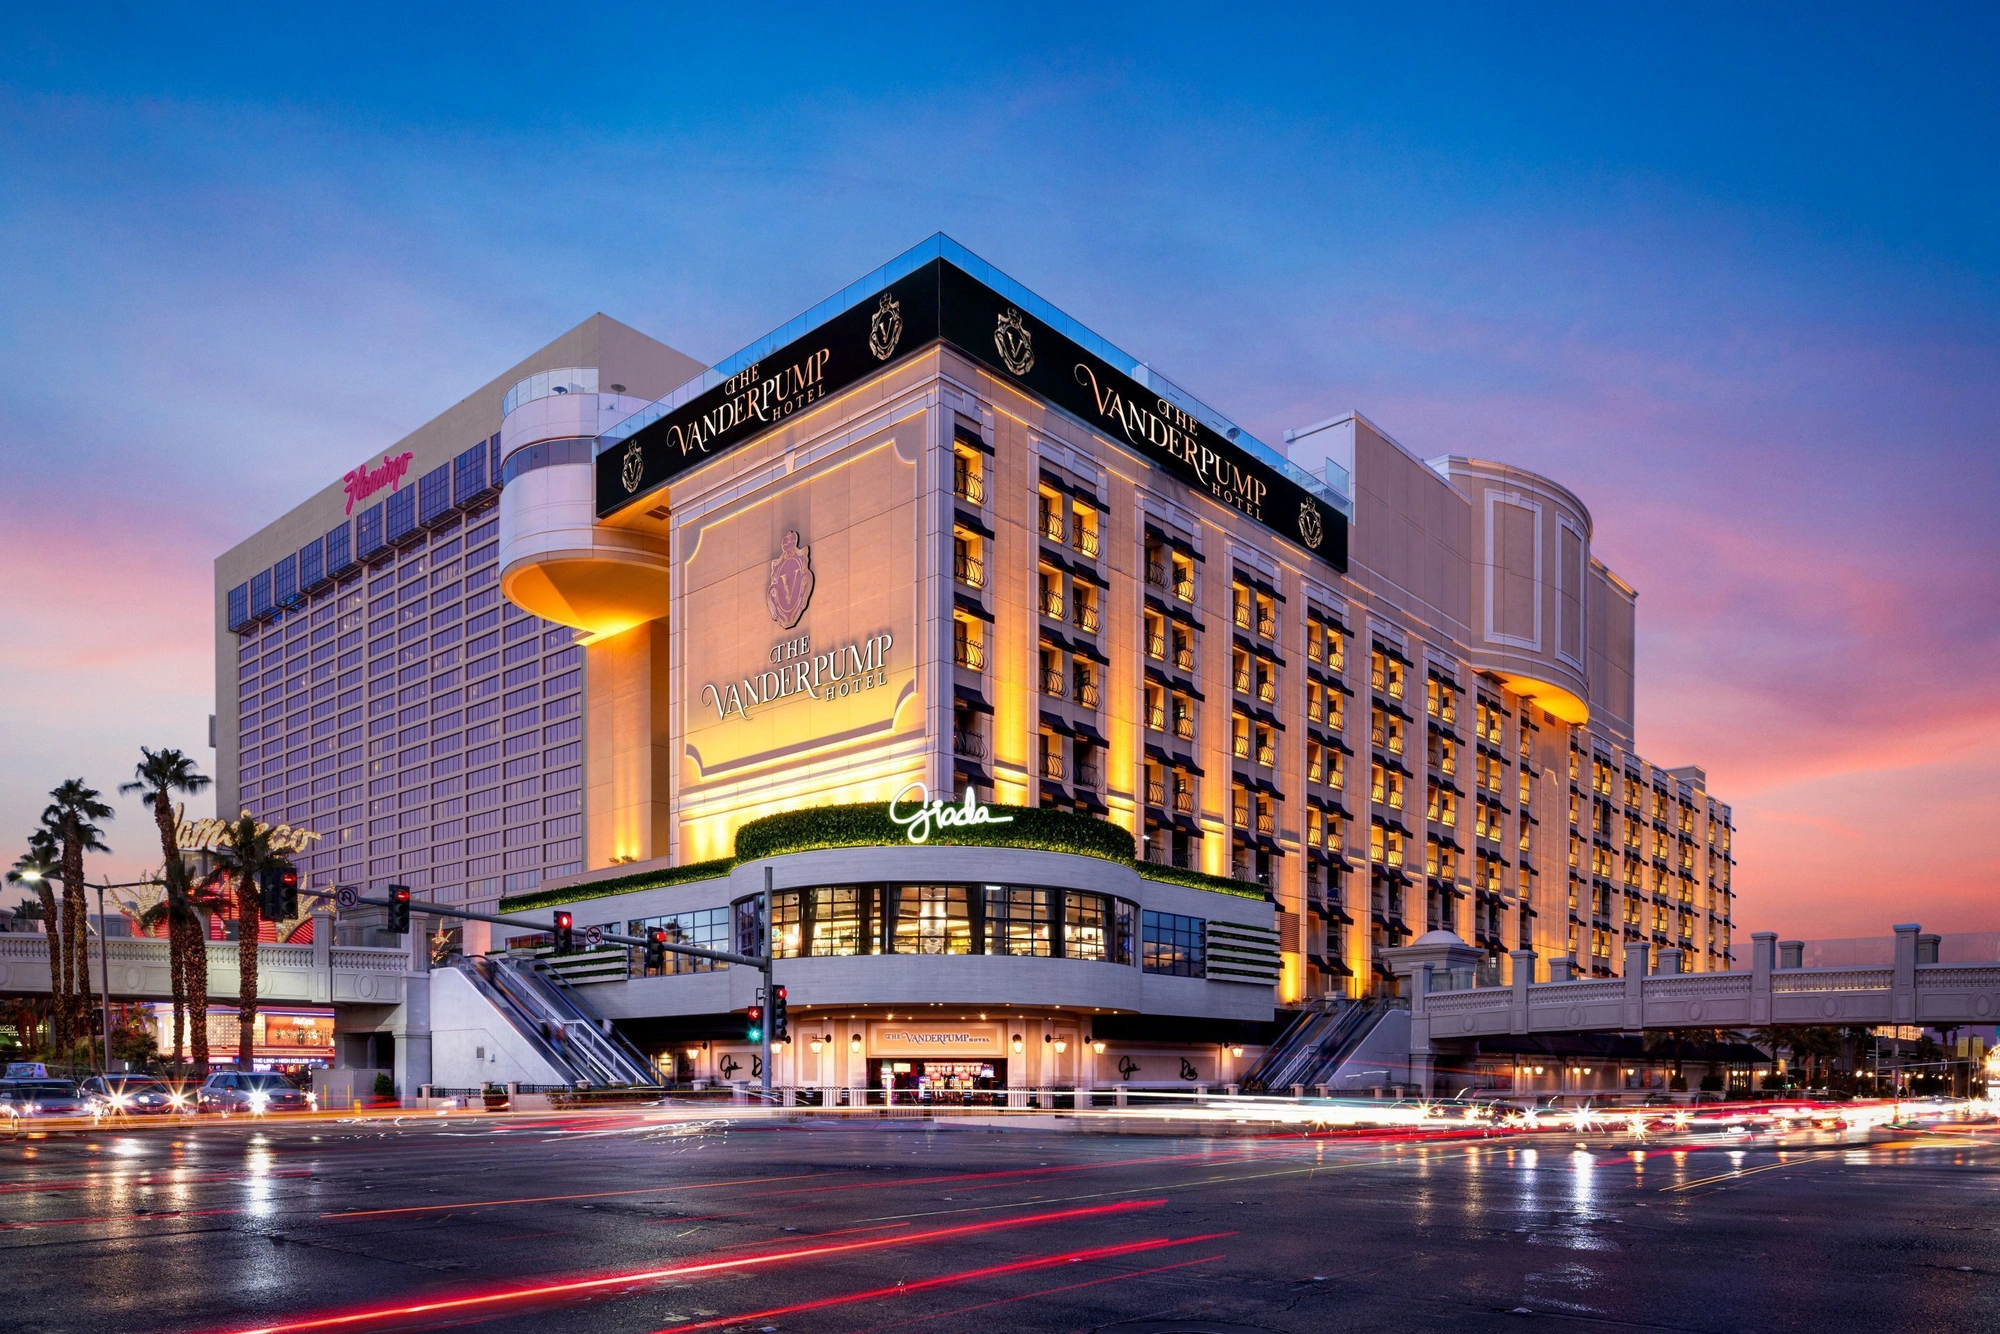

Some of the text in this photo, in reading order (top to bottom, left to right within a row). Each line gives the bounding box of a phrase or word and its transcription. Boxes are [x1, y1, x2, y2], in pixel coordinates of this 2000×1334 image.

[724, 363, 760, 396] THE
[666, 348, 830, 457] VANDERPUMP
[773, 384, 826, 422] HOTEL
[1157, 398, 1199, 437] THE
[1074, 363, 1267, 507] VANDERPUMP
[343, 450, 414, 516] Flamingo
[1212, 482, 1263, 522] HOTEL
[769, 635, 811, 664] THE
[700, 634, 894, 721] VANDERPUMP
[826, 671, 888, 702] HOTEL
[889, 781, 1014, 844] Giada
[901, 1032, 969, 1045] VANDERPUMP
